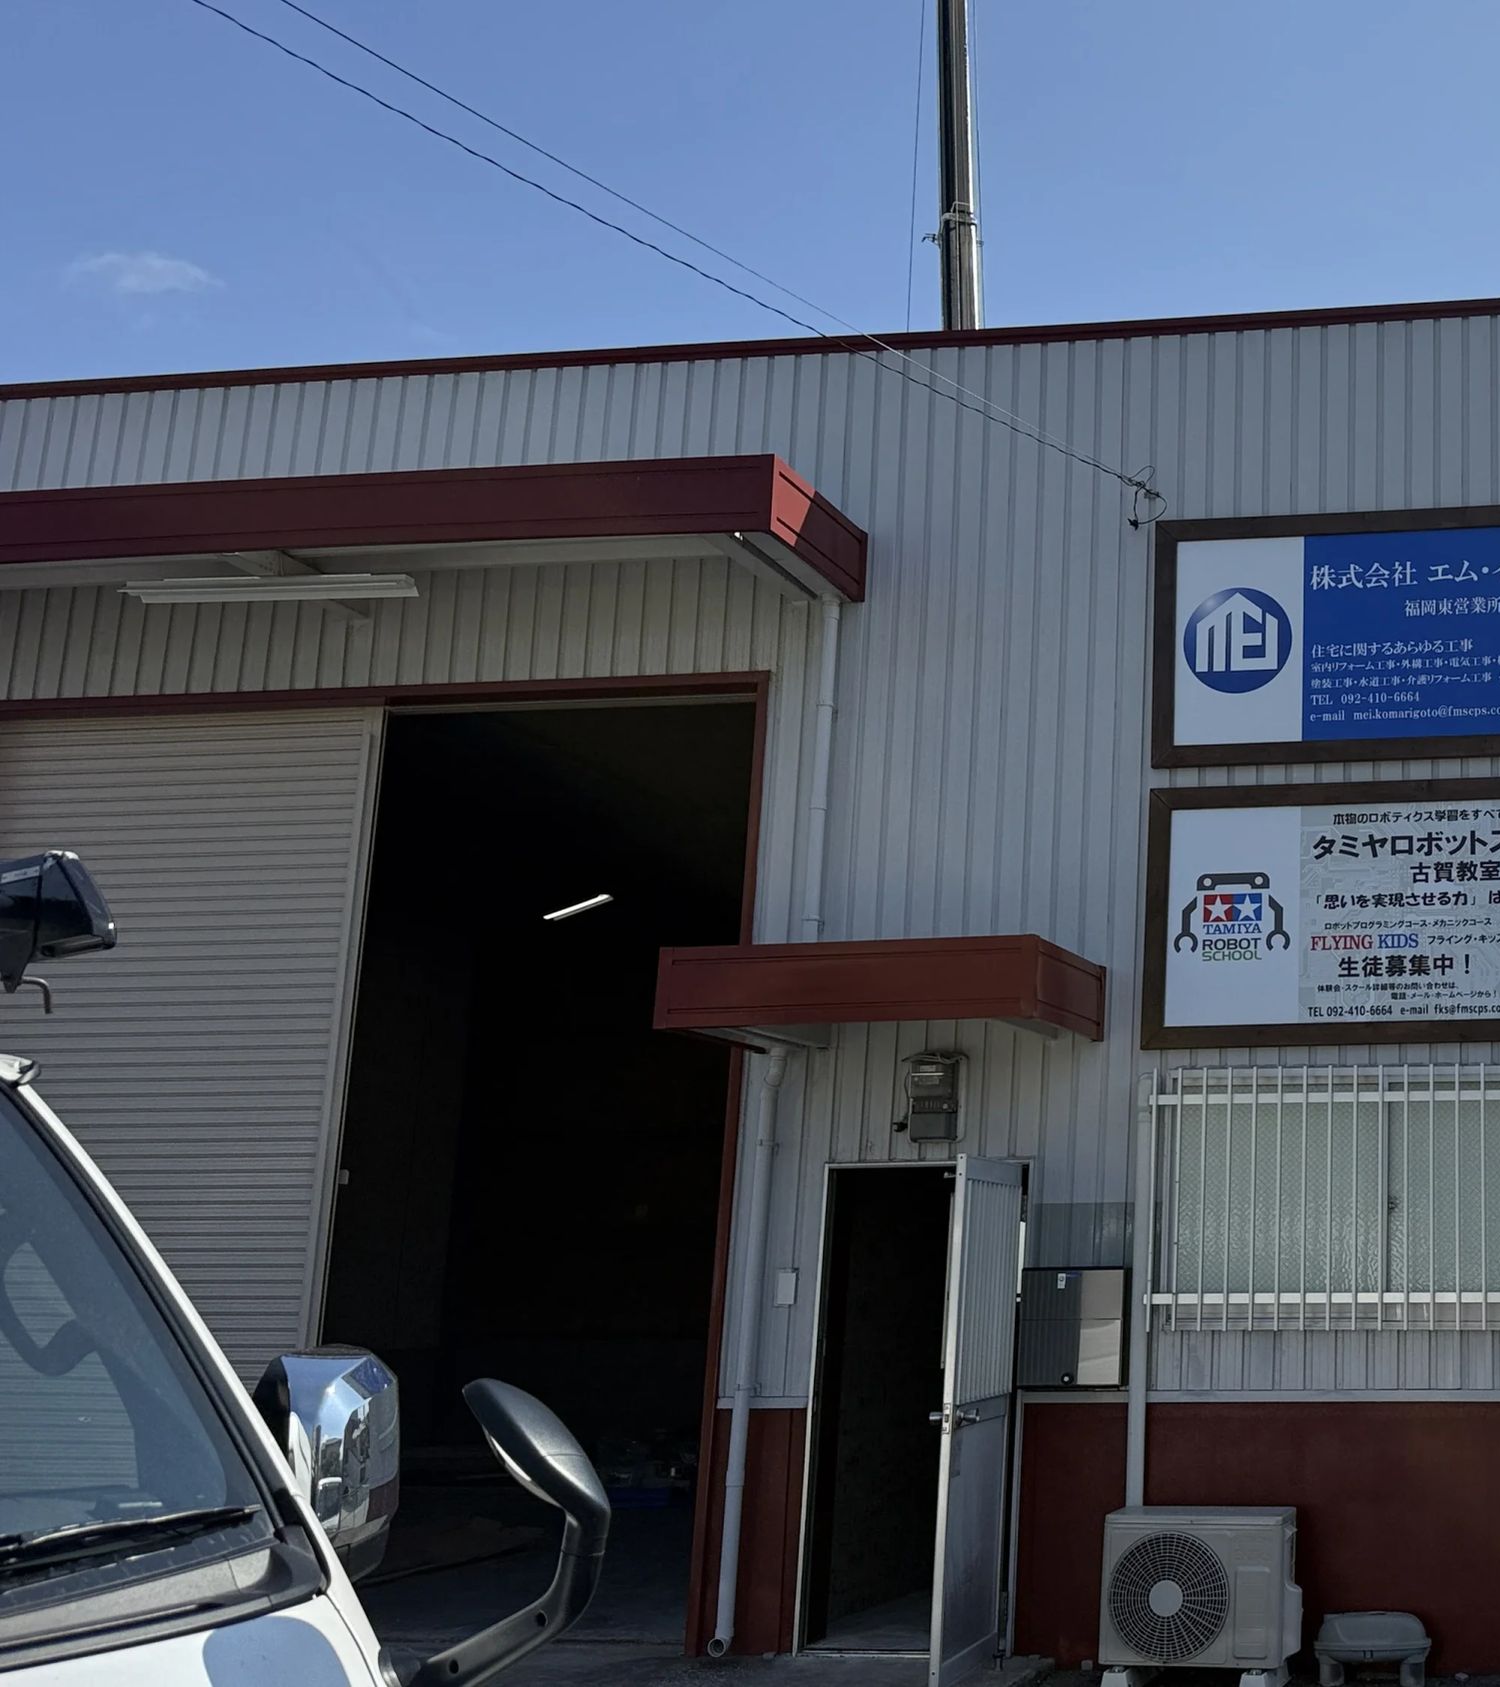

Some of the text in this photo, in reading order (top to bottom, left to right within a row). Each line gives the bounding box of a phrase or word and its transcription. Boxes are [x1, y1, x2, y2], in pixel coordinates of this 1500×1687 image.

[1310, 561, 1418, 590] 株式会社
[1312, 638, 1474, 659] 住宅に関するあらゆる工事
[1310, 691, 1420, 706] TEL 092-410-6664
[1310, 710, 1346, 722] e-mail
[1315, 892, 1478, 910] 「思いを実現させる力」
[1203, 923, 1262, 935] TAMIYA
[1202, 937, 1262, 951] ROBOT
[1310, 934, 1374, 951] FLYING
[1377, 932, 1419, 950] KIDS
[1202, 950, 1262, 962] SCHOOL
[1338, 953, 1471, 978] 生徒募集中！
[1308, 1006, 1325, 1018] TEL
[1326, 1004, 1393, 1018] 092-410-6664
[1400, 1003, 1429, 1016] e-mail
